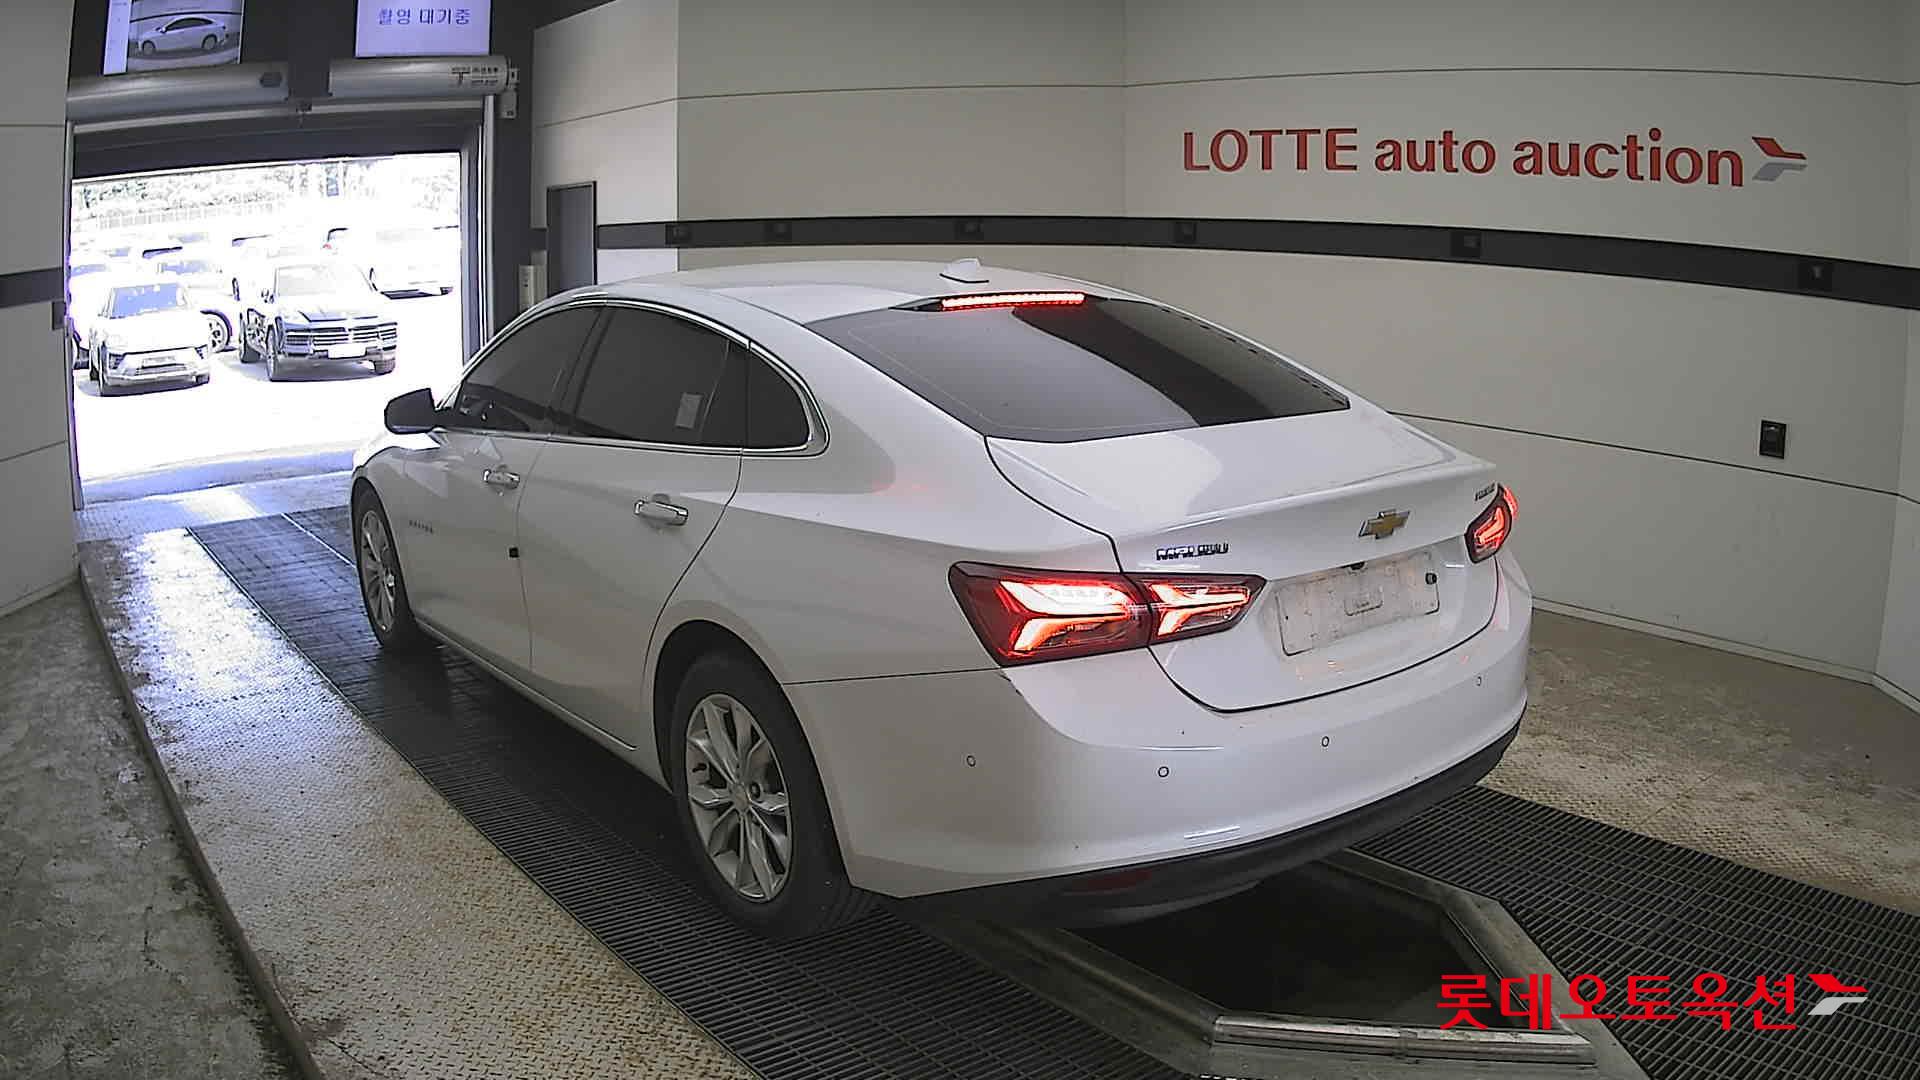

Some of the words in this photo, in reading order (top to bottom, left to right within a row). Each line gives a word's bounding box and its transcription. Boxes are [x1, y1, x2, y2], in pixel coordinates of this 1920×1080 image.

[419, 8, 470, 25] 대기중
[1183, 128, 1358, 172] LOTTE
[1374, 130, 1496, 174] auto
[1512, 128, 1744, 187] auction
